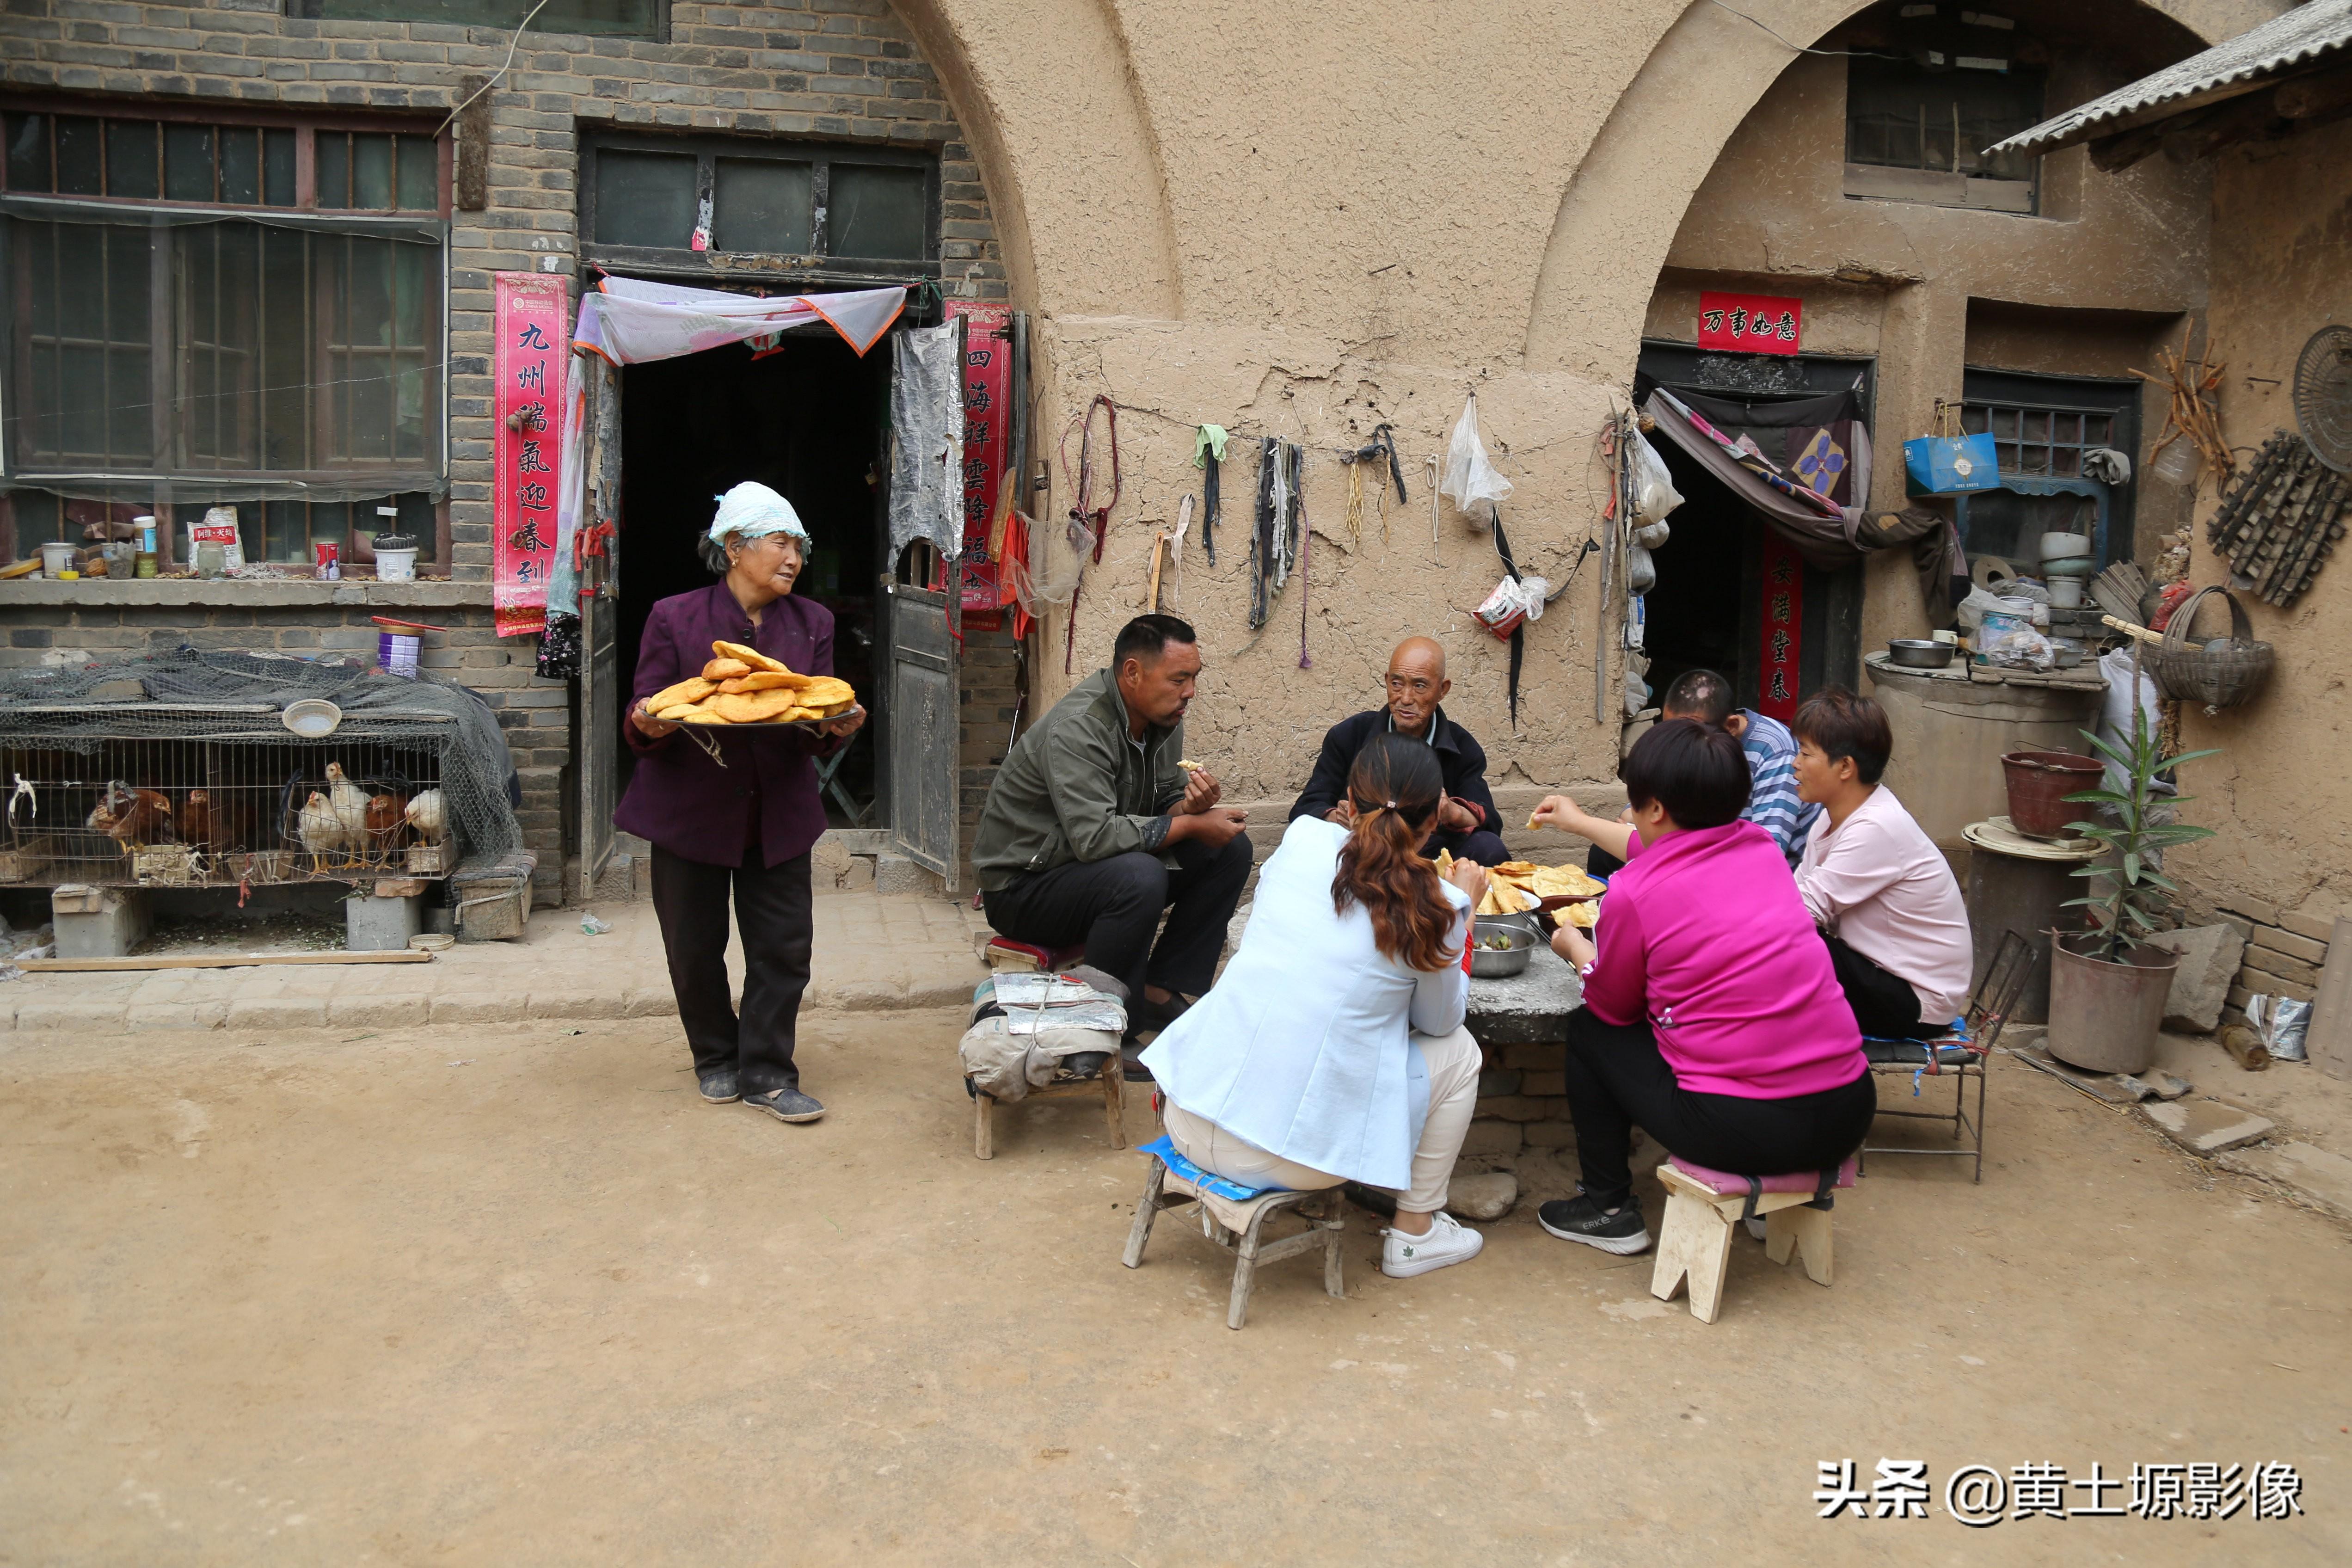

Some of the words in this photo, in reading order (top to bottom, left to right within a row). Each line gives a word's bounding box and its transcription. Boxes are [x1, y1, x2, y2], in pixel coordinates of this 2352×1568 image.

[1703, 306, 1796, 341] 万事如意
[1768, 555, 1794, 702] 安满堂春
[1583, 1217, 1610, 1230] ERKE
